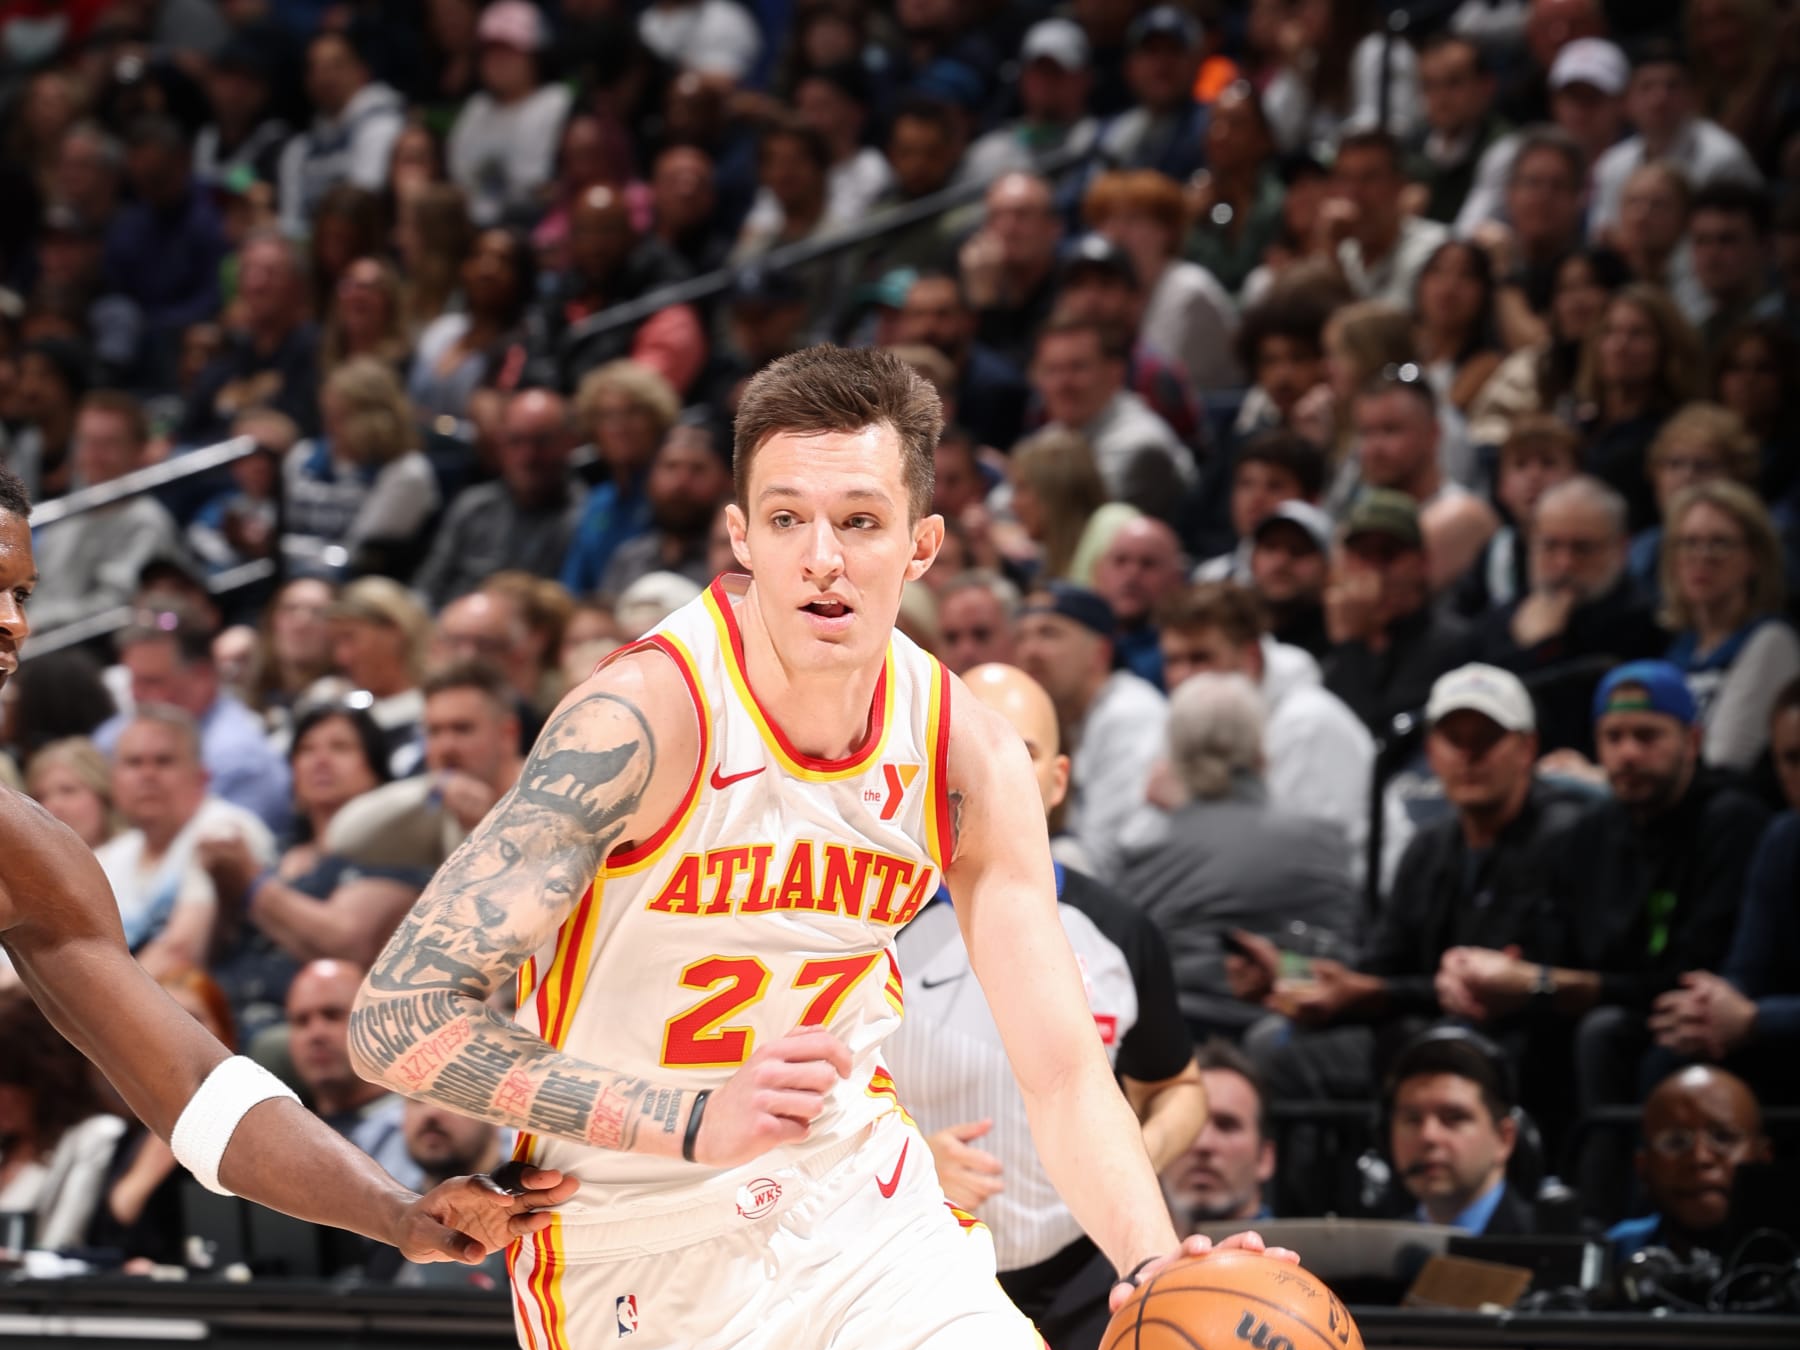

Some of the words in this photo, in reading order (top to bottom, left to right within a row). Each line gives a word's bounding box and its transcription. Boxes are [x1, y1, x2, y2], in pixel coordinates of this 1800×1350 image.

[864, 789, 881, 802] the
[645, 839, 934, 925] ATLANTA
[659, 951, 885, 1069] 27
[428, 1033, 523, 1112] COURAGE
[495, 1069, 538, 1117] FEAR
[527, 1069, 601, 1143] FAILURE
